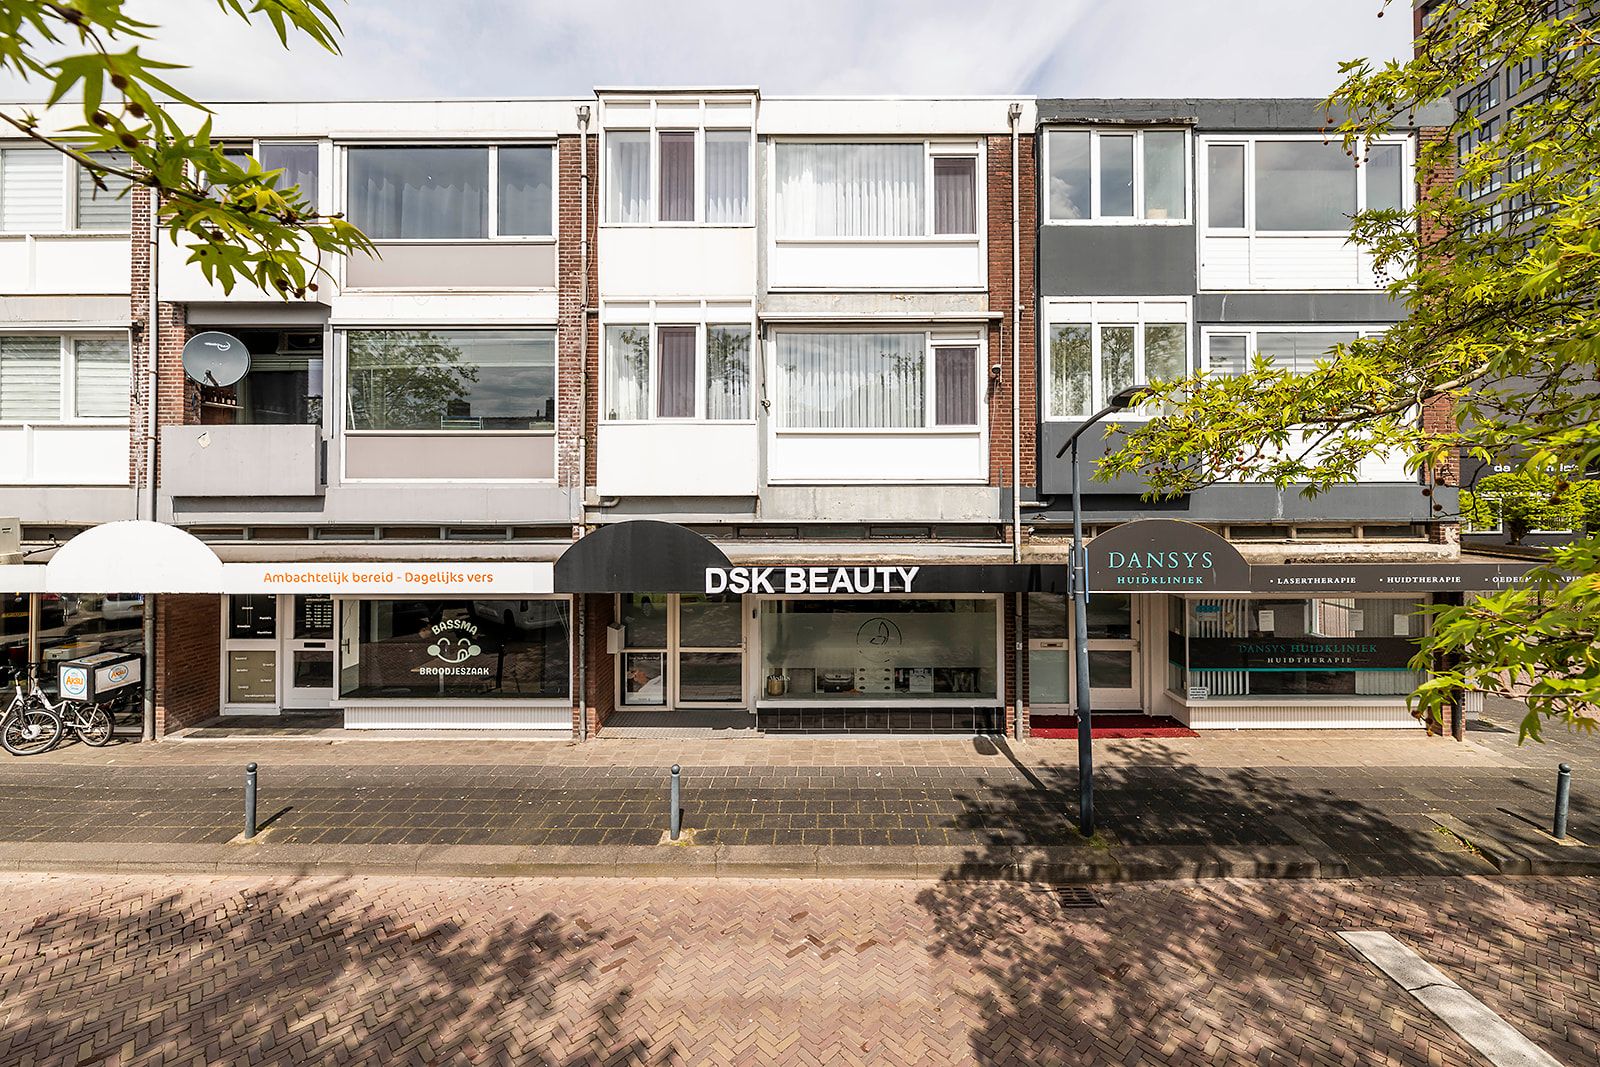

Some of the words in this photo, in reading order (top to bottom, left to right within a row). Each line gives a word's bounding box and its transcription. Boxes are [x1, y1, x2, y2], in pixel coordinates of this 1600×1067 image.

[1108, 551, 1214, 569] DANSYS
[263, 571, 349, 586] Ambachtelijk
[351, 571, 394, 583] bereid
[404, 571, 465, 586] Dagelijks
[467, 574, 494, 583] vers
[705, 567, 775, 594] DSK
[784, 566, 920, 594] BEAUTY
[1116, 575, 1203, 585] HUIDKLINIEK
[1277, 576, 1357, 585] LASERTHERAPIE
[1386, 575, 1462, 584] HUIDTHERAPIE
[431, 619, 478, 636] BASSMA
[1238, 644, 1287, 654] DANSYS
[1290, 643, 1378, 654] HUIDKLINIEK
[1266, 656, 1353, 665] HUIDTHERAPIE
[419, 667, 490, 676] BROODJESZAAK
